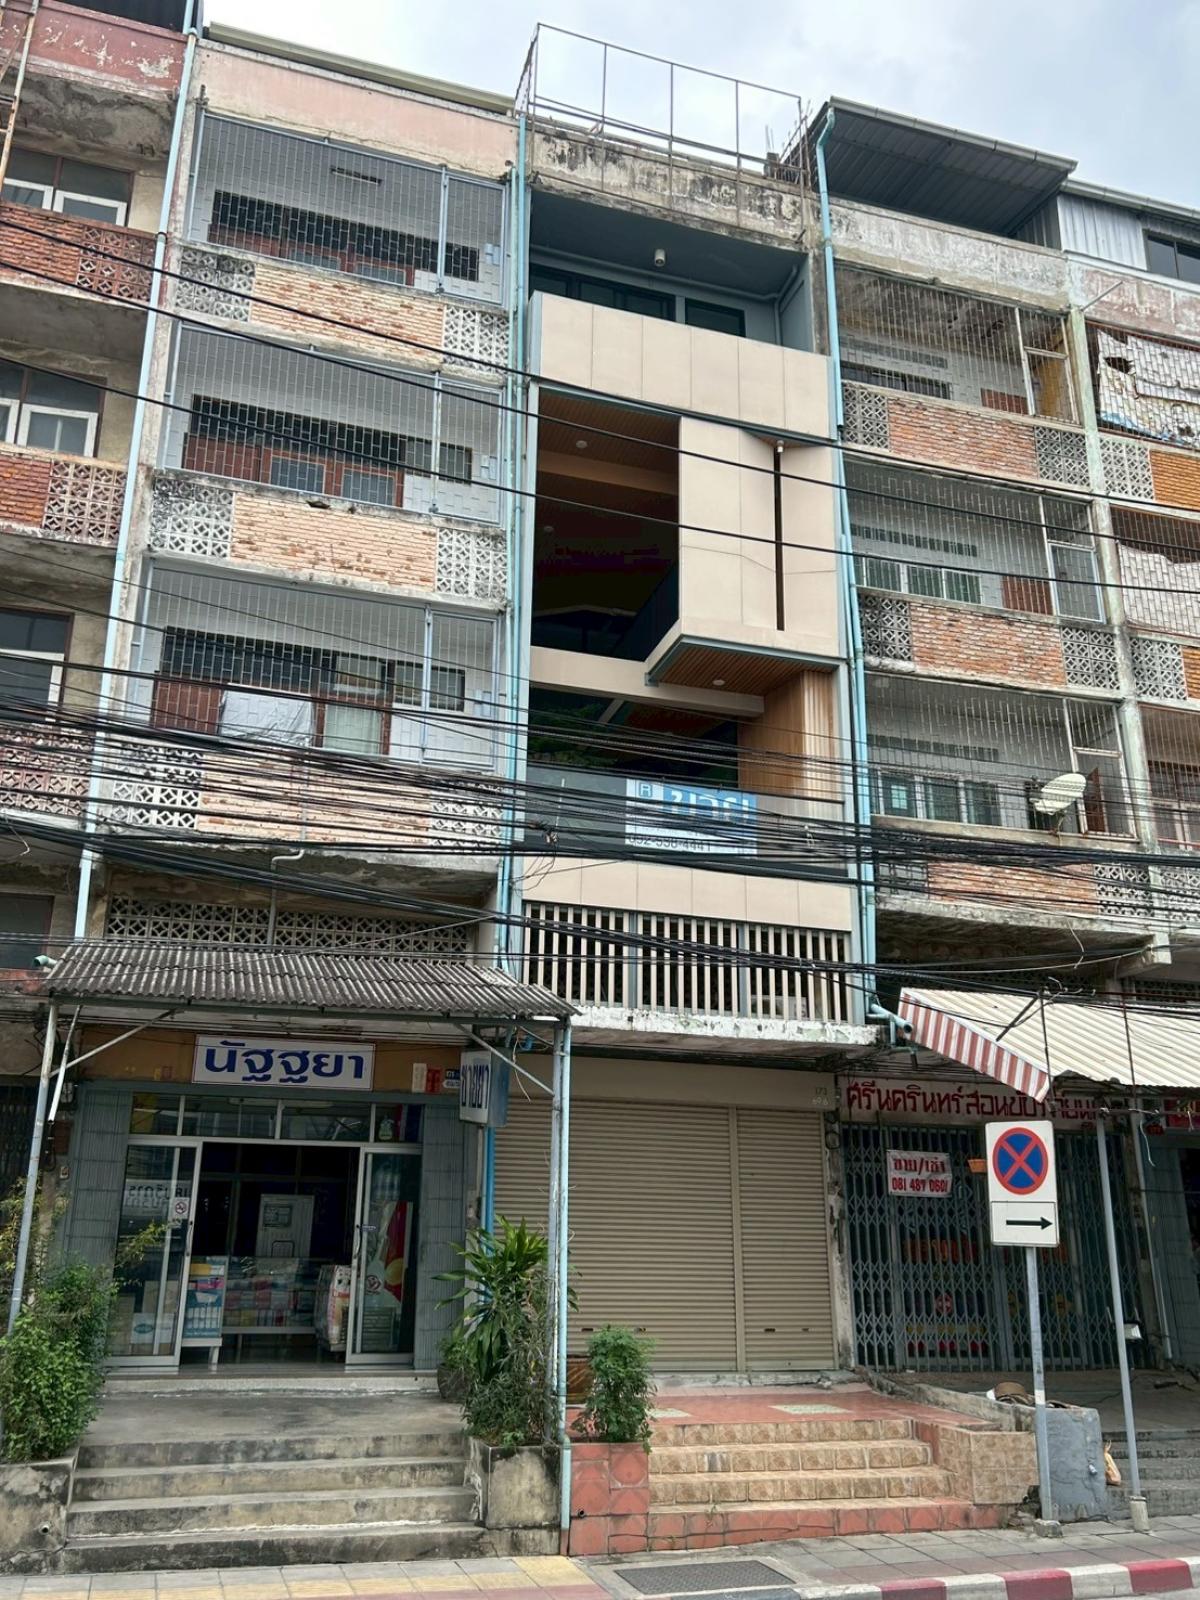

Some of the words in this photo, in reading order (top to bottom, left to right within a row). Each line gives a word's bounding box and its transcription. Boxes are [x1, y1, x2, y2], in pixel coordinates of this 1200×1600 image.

[205, 1040, 364, 1083] นัฐฐยา
[893, 1157, 946, 1175] ขาย/เช่า
[892, 1177, 906, 1191] 081
